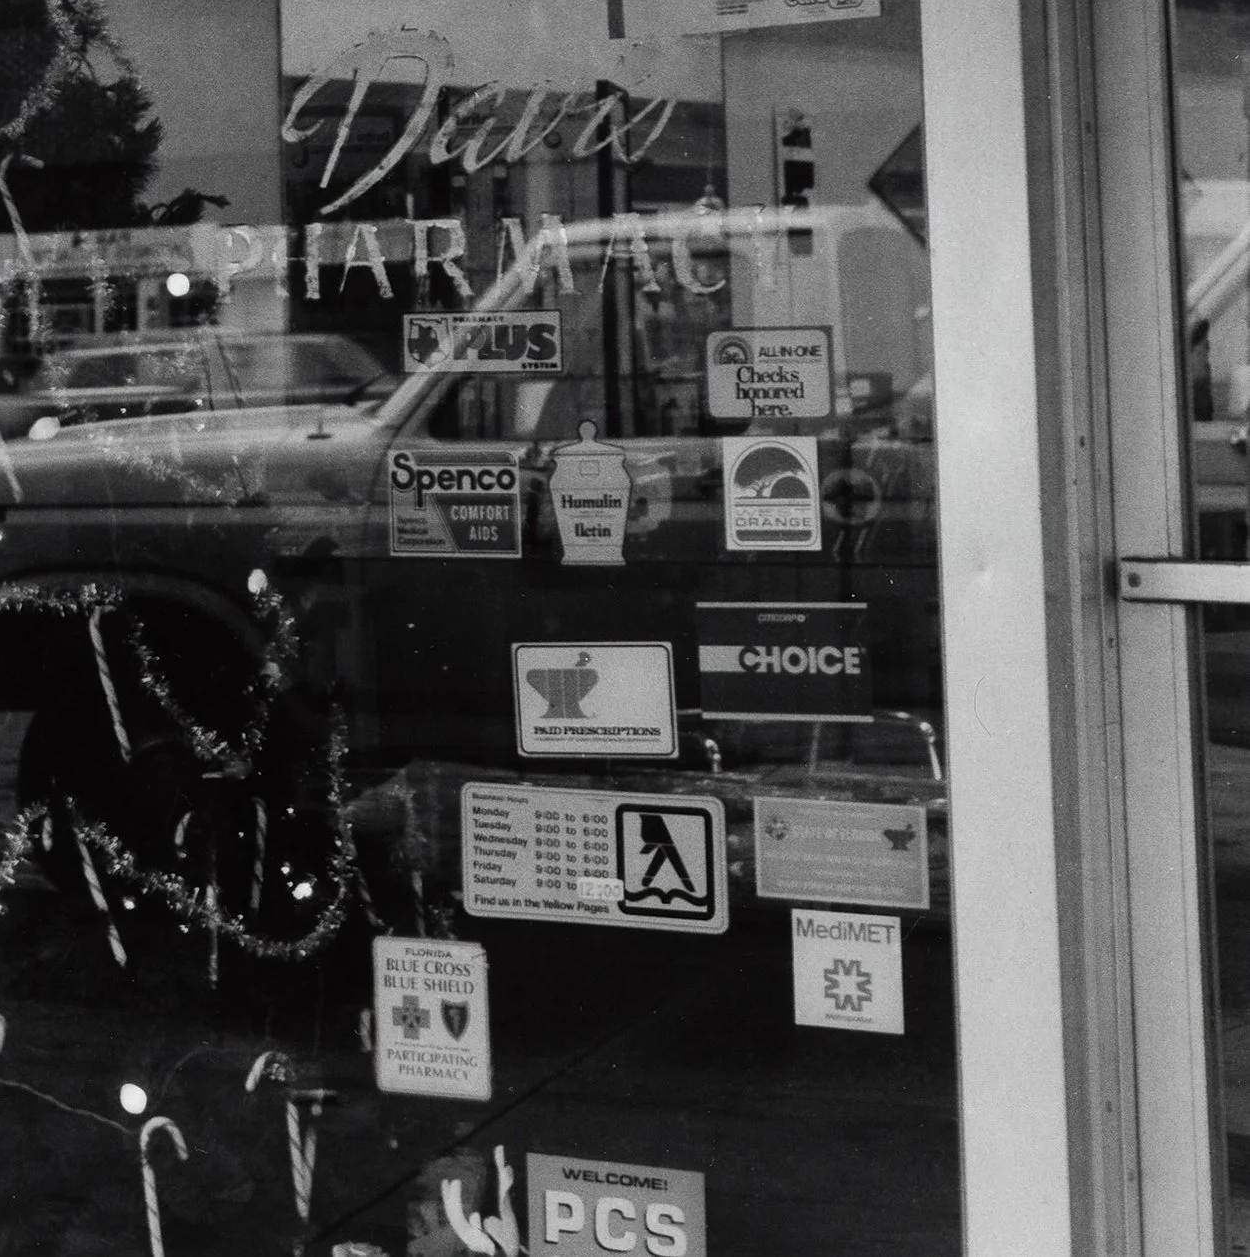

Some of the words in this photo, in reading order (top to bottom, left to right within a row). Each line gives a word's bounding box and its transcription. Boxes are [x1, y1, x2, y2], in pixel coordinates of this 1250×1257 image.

[453, 323, 557, 361] PLUS
[521, 362, 559, 370] SYSTEM
[736, 366, 800, 384] Checks
[735, 382, 805, 400] honored
[750, 399, 793, 416] here.
[391, 452, 516, 508] Spenco
[561, 493, 622, 509] Humulin
[451, 505, 510, 521] COMFORT
[735, 517, 812, 527] ORANGE
[469, 526, 499, 541] AIDS
[738, 645, 862, 675] CHOICE
[533, 726, 562, 735] PAID
[564, 726, 662, 736] PRESCRIPTIONS
[472, 806, 510, 819] Monday
[565, 813, 576, 823] to
[582, 814, 608, 825] 6:00
[473, 819, 512, 832] Tuesday
[566, 826, 577, 836] to
[583, 827, 609, 838] 6:00
[473, 833, 528, 848] Wednesday
[566, 840, 577, 850] to
[583, 841, 609, 852] 6:00
[473, 845, 517, 860] Thursday
[566, 854, 577, 863] to
[583, 854, 609, 865] 6:00
[473, 860, 502, 872] Friday
[566, 868, 577, 877] to
[584, 868, 609, 878] 6:00
[473, 874, 517, 887] Saturday
[536, 878, 561, 889] 9:00
[567, 881, 577, 891] to
[474, 894, 495, 906] Find
[498, 898, 510, 907] us
[512, 897, 522, 907] in
[524, 898, 540, 909] the
[542, 899, 575, 911] Yellow
[577, 901, 610, 914] Pages
[796, 917, 896, 944] MediMET
[405, 947, 452, 959] FLORIDA
[386, 958, 420, 973] BLUE
[424, 960, 471, 977] CROSS
[384, 975, 418, 990] BLUE
[423, 978, 474, 994] SHIELD
[387, 1048, 478, 1067] PARTICIPATING
[399, 1064, 469, 1080] PHARMACY
[563, 1167, 669, 1191] WELCOME!
[544, 1190, 687, 1257] PCS
